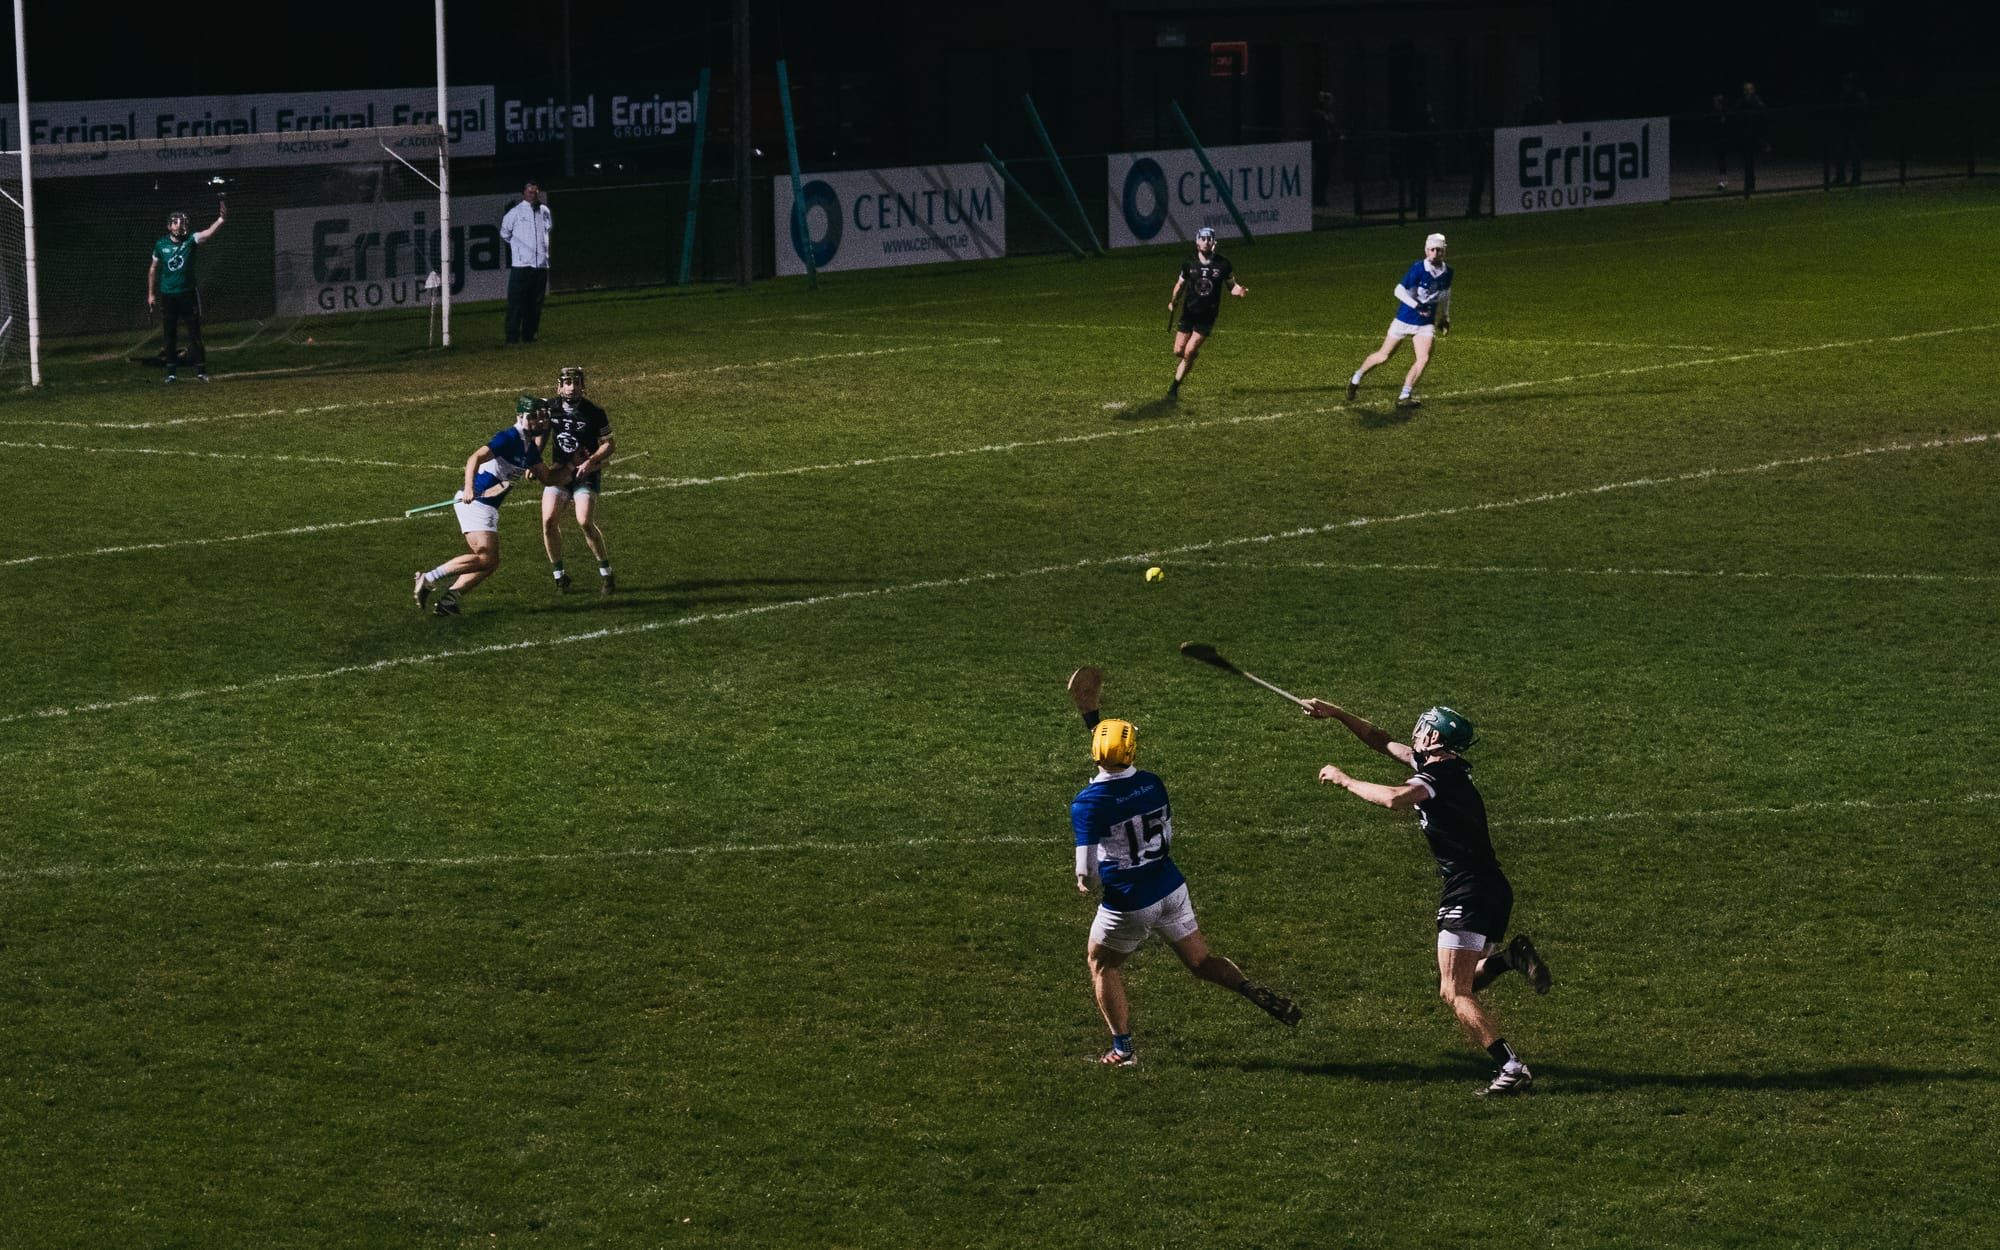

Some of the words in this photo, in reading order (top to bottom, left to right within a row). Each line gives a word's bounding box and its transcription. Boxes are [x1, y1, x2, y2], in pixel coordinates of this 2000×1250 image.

[156, 107, 257, 155] Errigal
[277, 103, 374, 148] Errigal
[393, 98, 485, 143] Errgal
[611, 88, 698, 135] Errigal
[613, 126, 661, 139] GROUP
[1519, 123, 1649, 199] Errigal
[1178, 164, 1301, 206] CENTUM
[1521, 186, 1592, 209] GROUP
[853, 187, 993, 231] CENTUM
[318, 279, 430, 310] GROUP
[1124, 809, 1168, 866] 15
